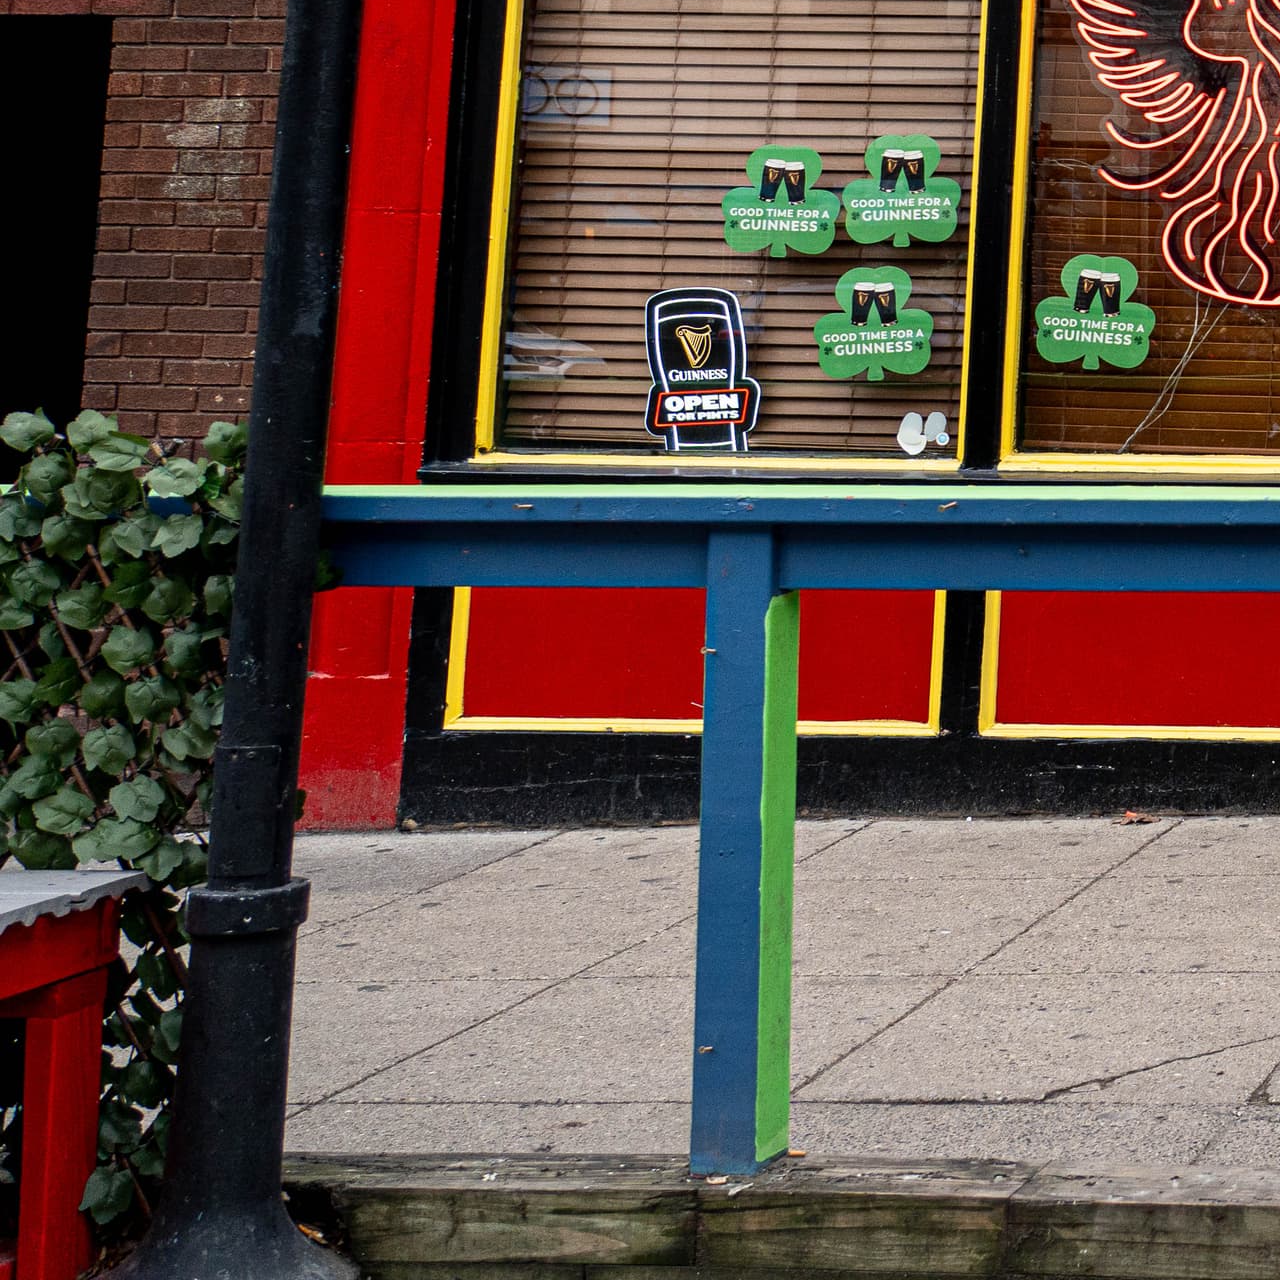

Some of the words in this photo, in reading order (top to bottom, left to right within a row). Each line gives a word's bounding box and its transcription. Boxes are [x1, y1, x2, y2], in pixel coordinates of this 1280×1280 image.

[851, 199, 885, 209] GOOD
[887, 198, 915, 208] TIME
[918, 197, 942, 207] FOR
[943, 197, 952, 206] A
[729, 207, 764, 218] GOOD
[766, 208, 794, 219] TIME
[797, 209, 820, 219] FOR
[821, 210, 830, 219] A
[861, 208, 940, 221] GUINNESS
[739, 218, 818, 232] GUINNESS
[1043, 316, 1078, 328] GOOD
[1080, 319, 1108, 330] TIME
[1110, 322, 1134, 332] FOR
[1136, 324, 1145, 333] A
[822, 332, 857, 343] GOOD
[859, 330, 888, 341] TIME
[890, 329, 913, 339] FOR
[915, 328, 924, 338] A
[1053, 329, 1132, 345] GUINNESS
[833, 340, 913, 356] GUINNESS
[668, 368, 728, 382] GUINNESS
[664, 393, 739, 412] OPEN
[667, 411, 697, 421] FOR
[699, 409, 740, 421] PINTS
